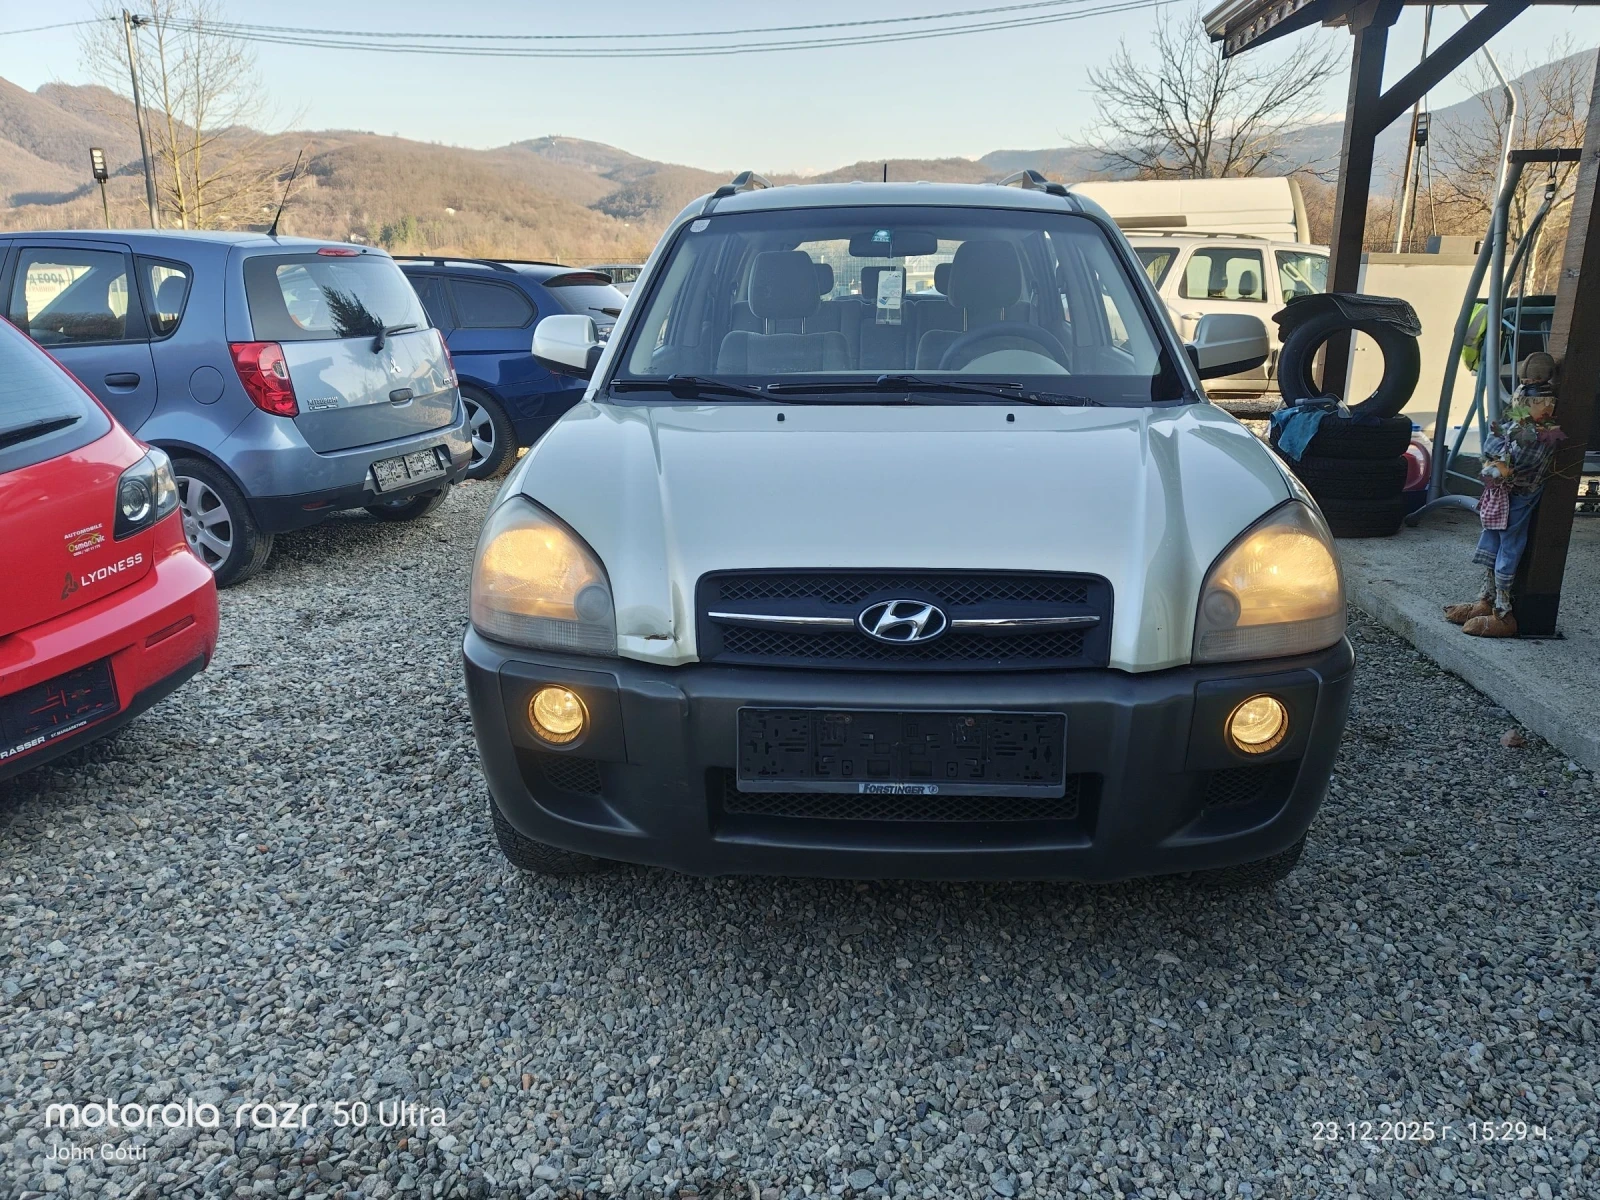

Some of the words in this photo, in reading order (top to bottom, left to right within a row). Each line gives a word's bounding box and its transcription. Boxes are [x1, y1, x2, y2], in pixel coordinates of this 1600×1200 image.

[64, 523, 103, 540] AUTOMOBILE
[81, 552, 143, 587] LYONESS
[0, 736, 46, 759] RASSER
[863, 783, 925, 794] FORSTINGER
